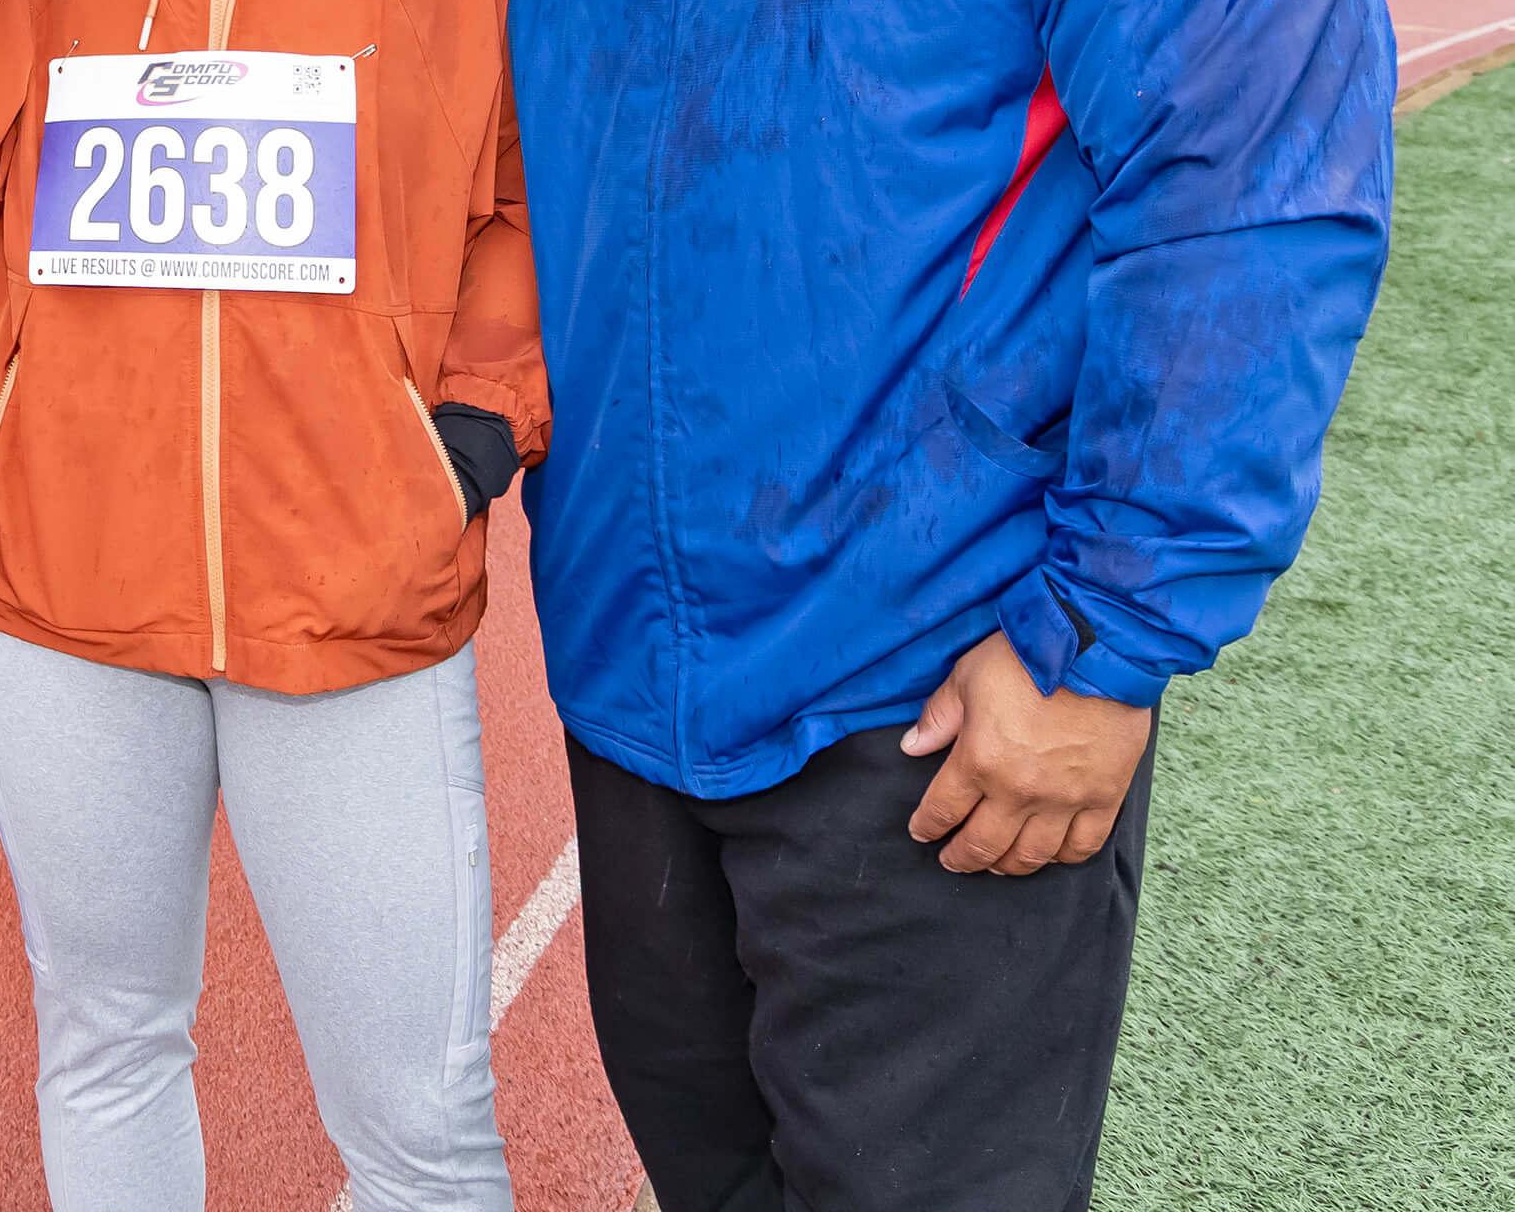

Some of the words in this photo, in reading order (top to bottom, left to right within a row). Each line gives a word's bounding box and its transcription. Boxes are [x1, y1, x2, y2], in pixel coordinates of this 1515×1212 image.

[137, 61, 233, 85] COMPU
[148, 75, 240, 97] SCORE
[68, 125, 315, 247] 2638
[51, 257, 77, 274] LIVE
[82, 258, 136, 275] RESULTS
[140, 258, 156, 277] @
[160, 259, 330, 281] WWW.COMPUSCORE.COM
